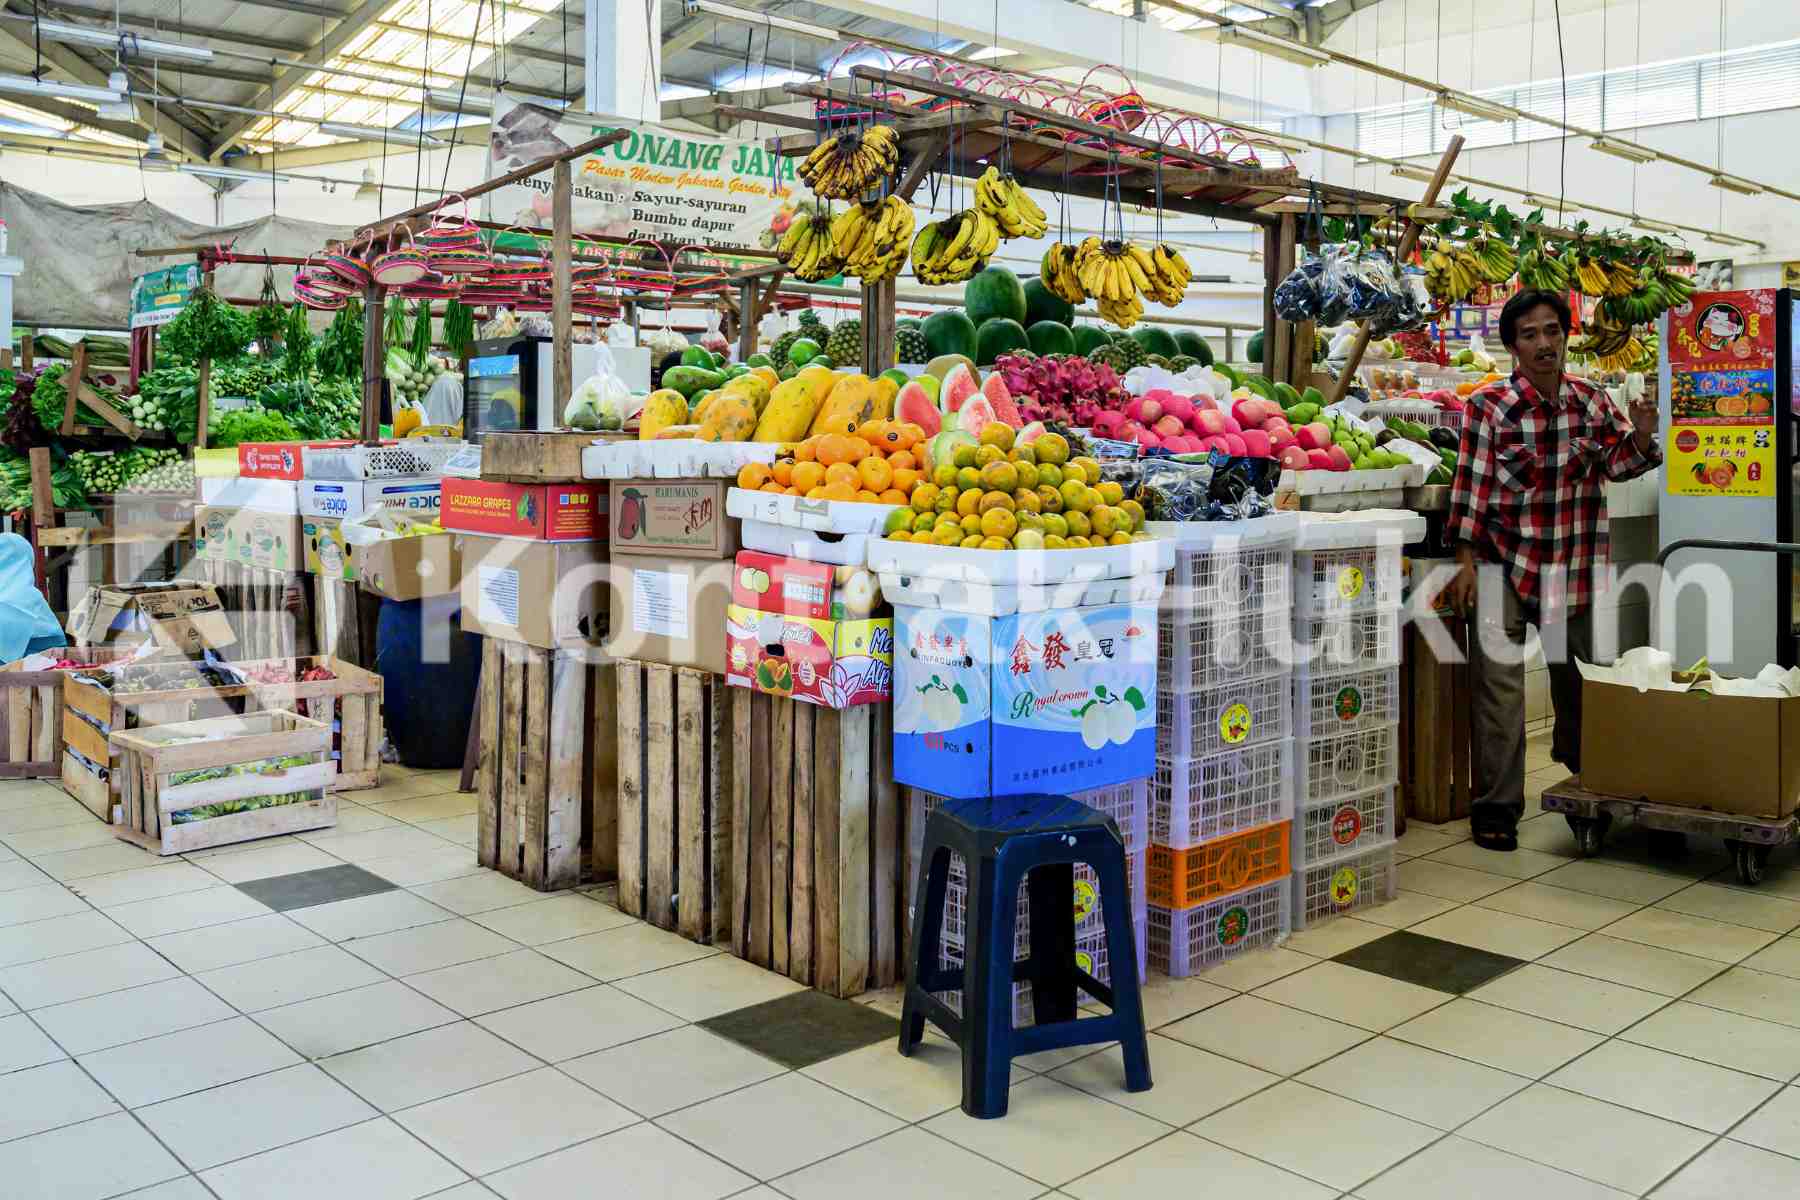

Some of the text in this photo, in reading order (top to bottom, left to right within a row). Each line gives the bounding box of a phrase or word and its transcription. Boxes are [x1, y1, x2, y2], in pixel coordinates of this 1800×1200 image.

[591, 125, 796, 181] TONANG JAYA
[583, 159, 625, 177] Pasar
[675, 172, 724, 190] Jakarta
[510, 175, 613, 202] enyakan
[632, 190, 747, 214] Sayur-sayuran
[631, 208, 735, 232] Bumbu dapur
[1010, 688, 1089, 720] Royal crown
